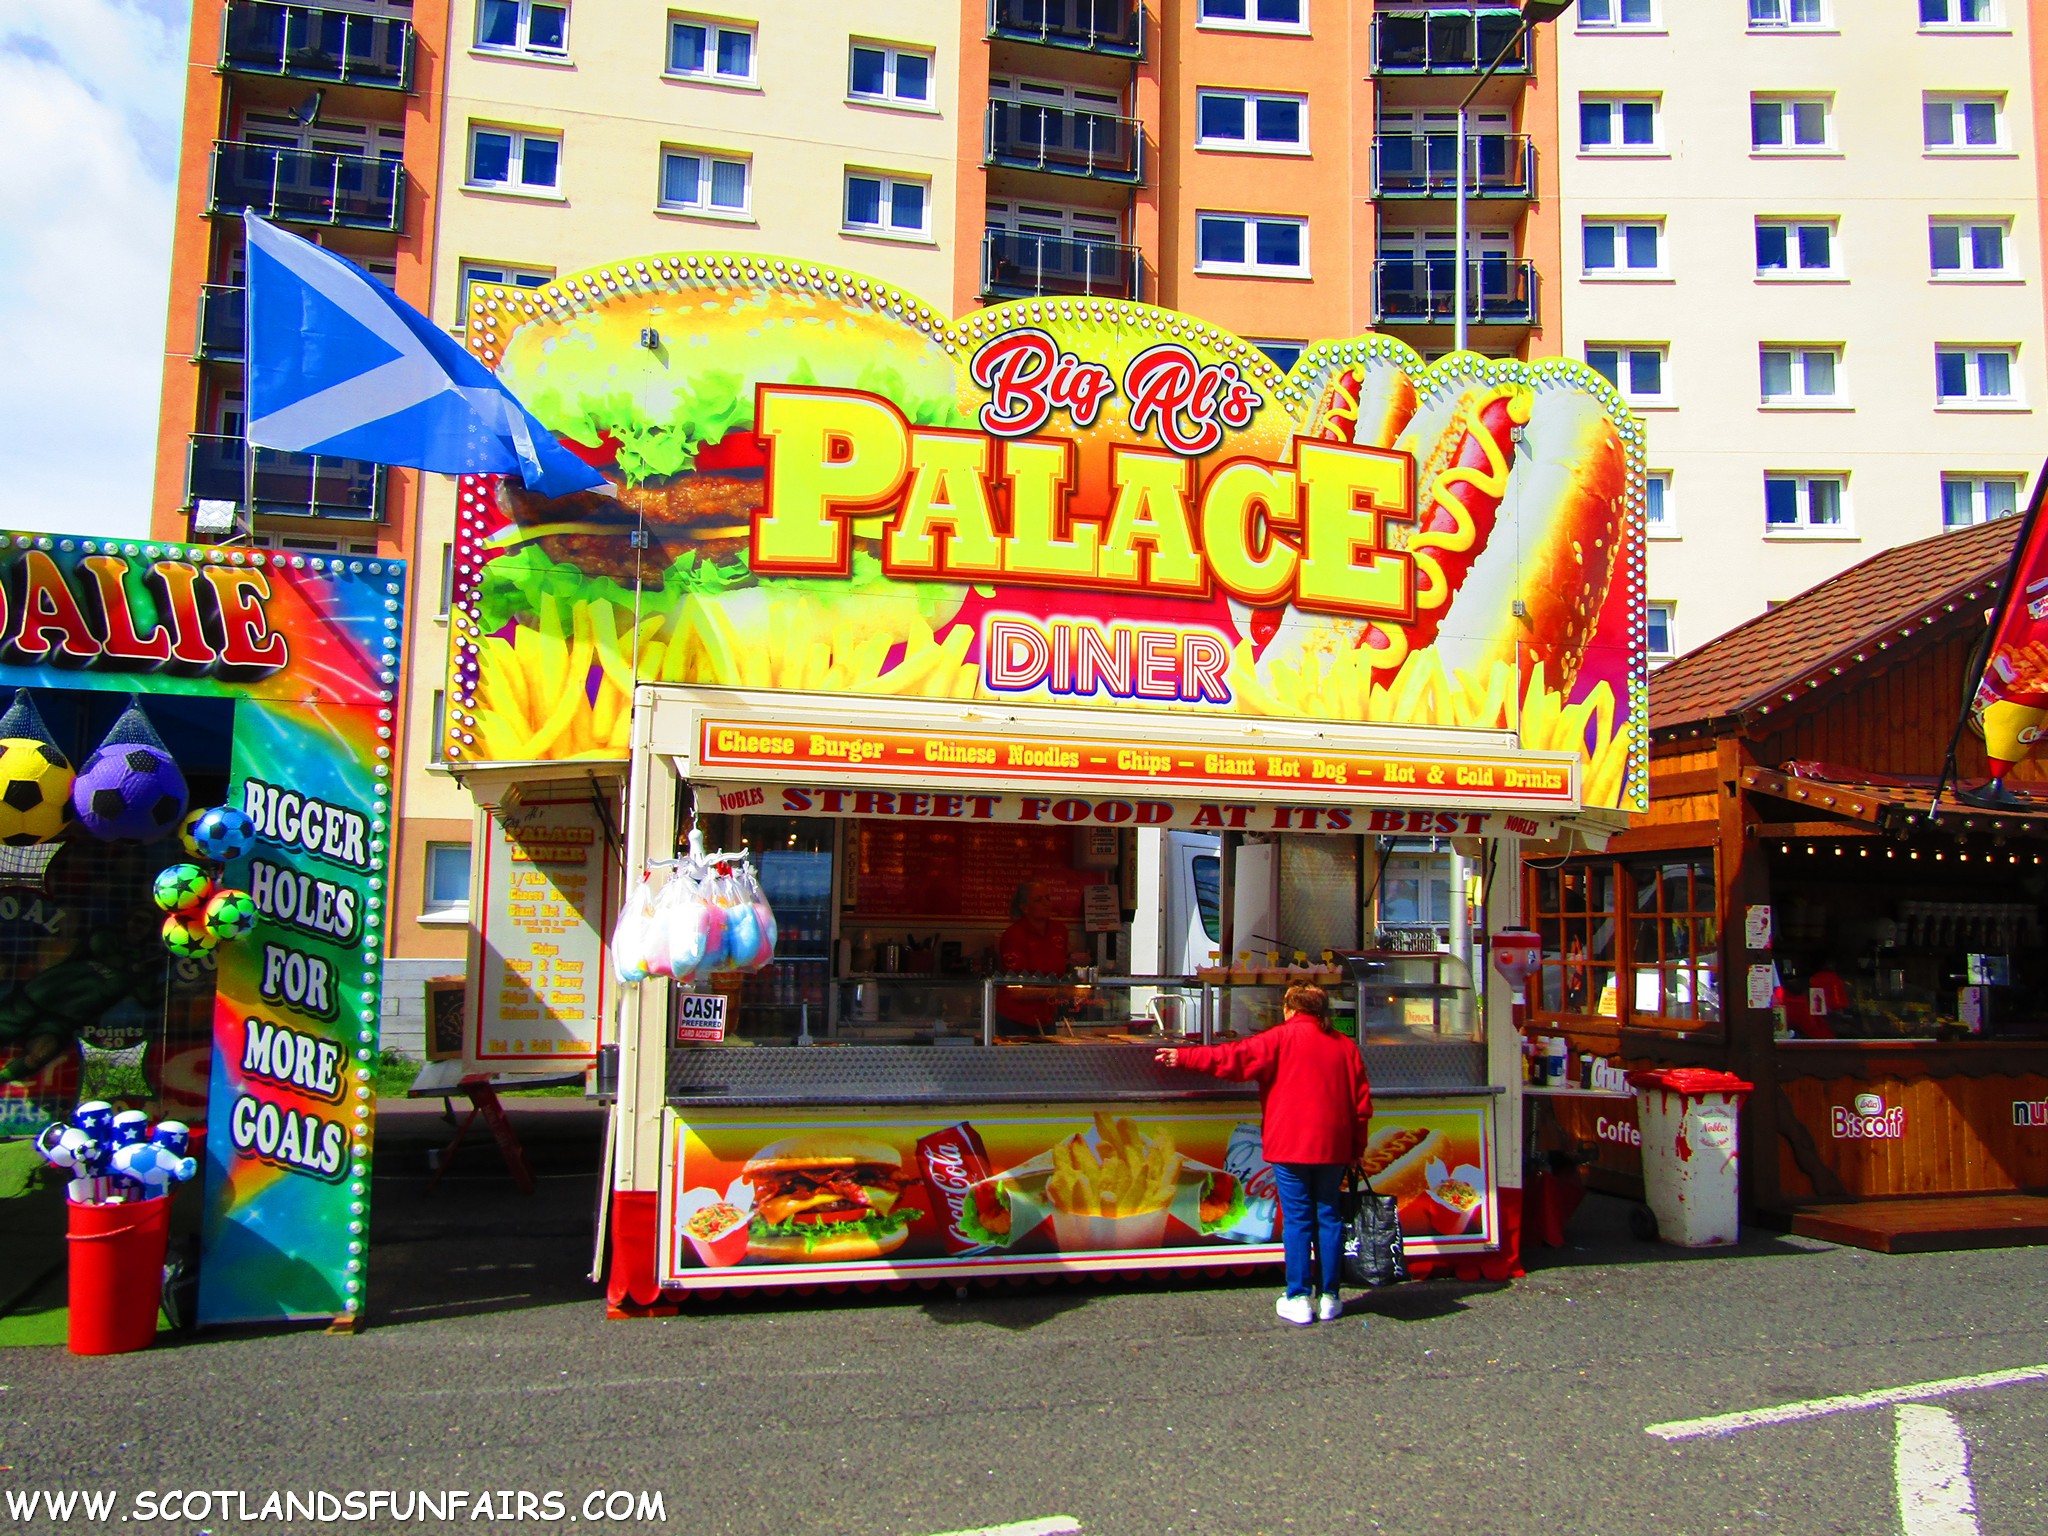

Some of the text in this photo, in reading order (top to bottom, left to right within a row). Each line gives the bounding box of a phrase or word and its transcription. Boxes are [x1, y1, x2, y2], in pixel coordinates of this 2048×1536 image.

[971, 328, 1261, 454] Big Al's
[750, 384, 1413, 621] PALACE
[0, 551, 288, 668] ALIE
[986, 616, 1230, 703] DINER
[718, 730, 795, 754] Cheese
[809, 735, 884, 762] Burger
[925, 741, 996, 764] Chinese
[1008, 745, 1079, 767] Noodles
[1118, 750, 1171, 776] Chips
[1205, 754, 1256, 776] Giant
[1267, 757, 1300, 777] Hot
[1312, 760, 1347, 784] Dog
[1384, 763, 1416, 783] Hot
[1427, 767, 1445, 784] &
[1456, 767, 1494, 786] Cold
[1504, 769, 1562, 789] Drinks
[719, 787, 765, 812] NOBLES
[782, 788, 1492, 834] STREET FOOD AT ITS BEST
[246, 781, 366, 866] BIGGER
[1504, 815, 1540, 837] NOBLES
[511, 846, 586, 862] DINER
[0, 896, 66, 934] OAL
[251, 861, 354, 938] HOLES
[264, 944, 328, 1011] FOR
[681, 1019, 722, 1028] PREFERRED
[683, 997, 724, 1020] CASH
[83, 1025, 144, 1038] Points
[680, 1029, 722, 1039] CARD ACCEPTED
[245, 1019, 338, 1094] MORE
[1596, 1116, 1641, 1146] Coffe
[1832, 1106, 1903, 1138] Biscoff
[2013, 1098, 2048, 1125] nu
[232, 1097, 342, 1174] GOALS
